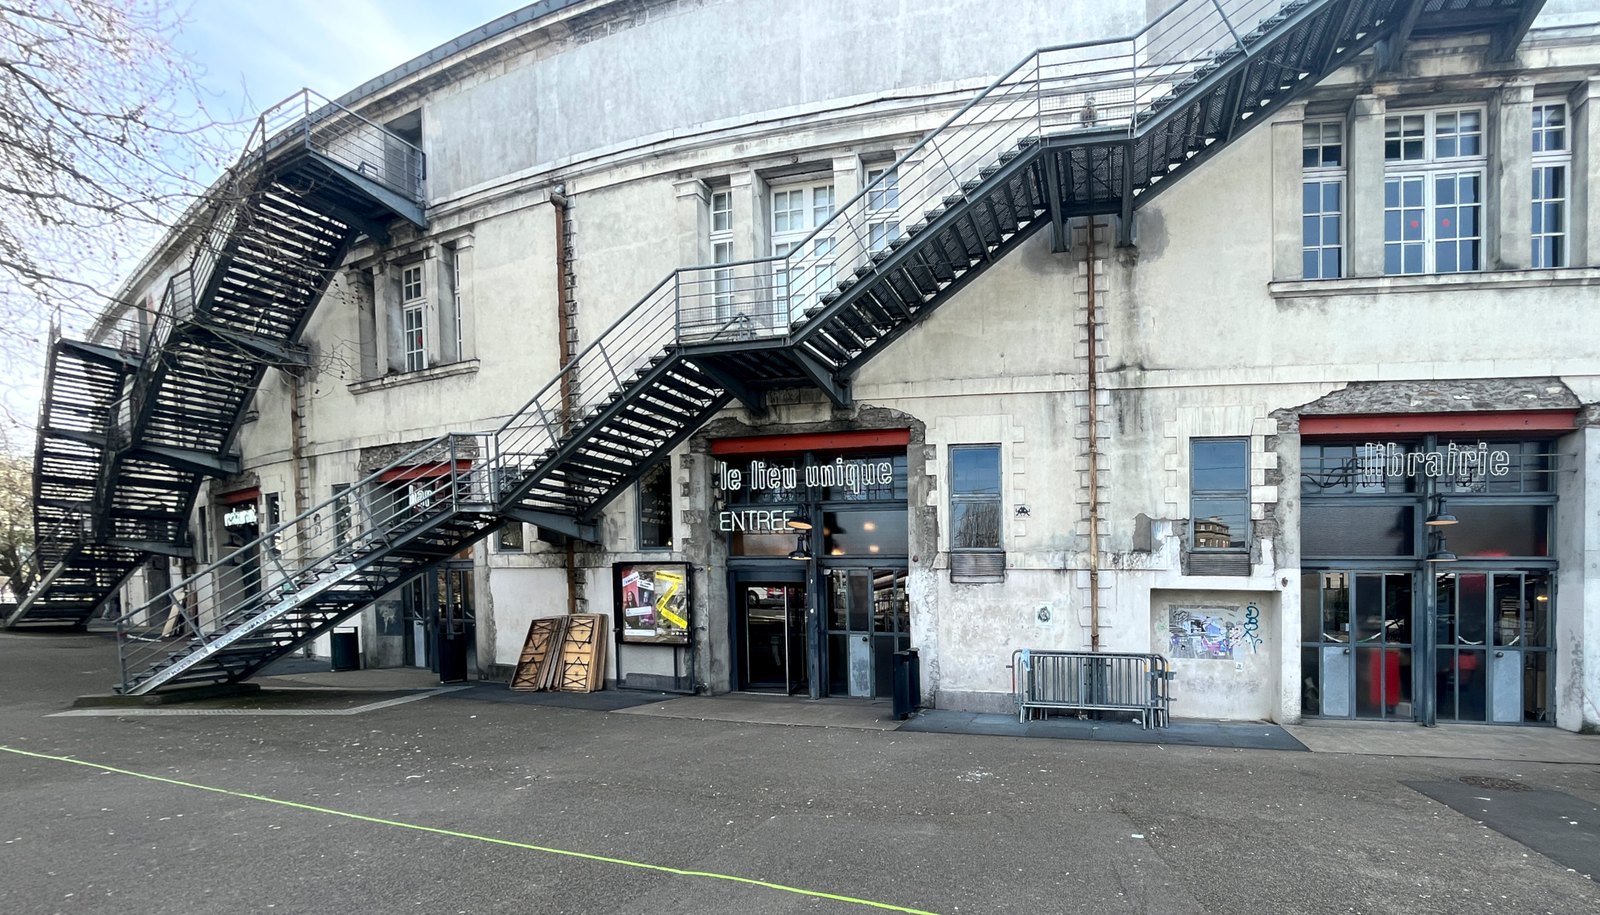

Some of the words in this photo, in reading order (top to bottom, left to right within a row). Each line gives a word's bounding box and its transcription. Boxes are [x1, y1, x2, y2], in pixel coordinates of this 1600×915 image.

[720, 461, 742, 491] le
[751, 460, 797, 490] lieu
[805, 457, 893, 495] unique
[1365, 442, 1510, 477] librairie
[719, 509, 795, 532] ENTREE
